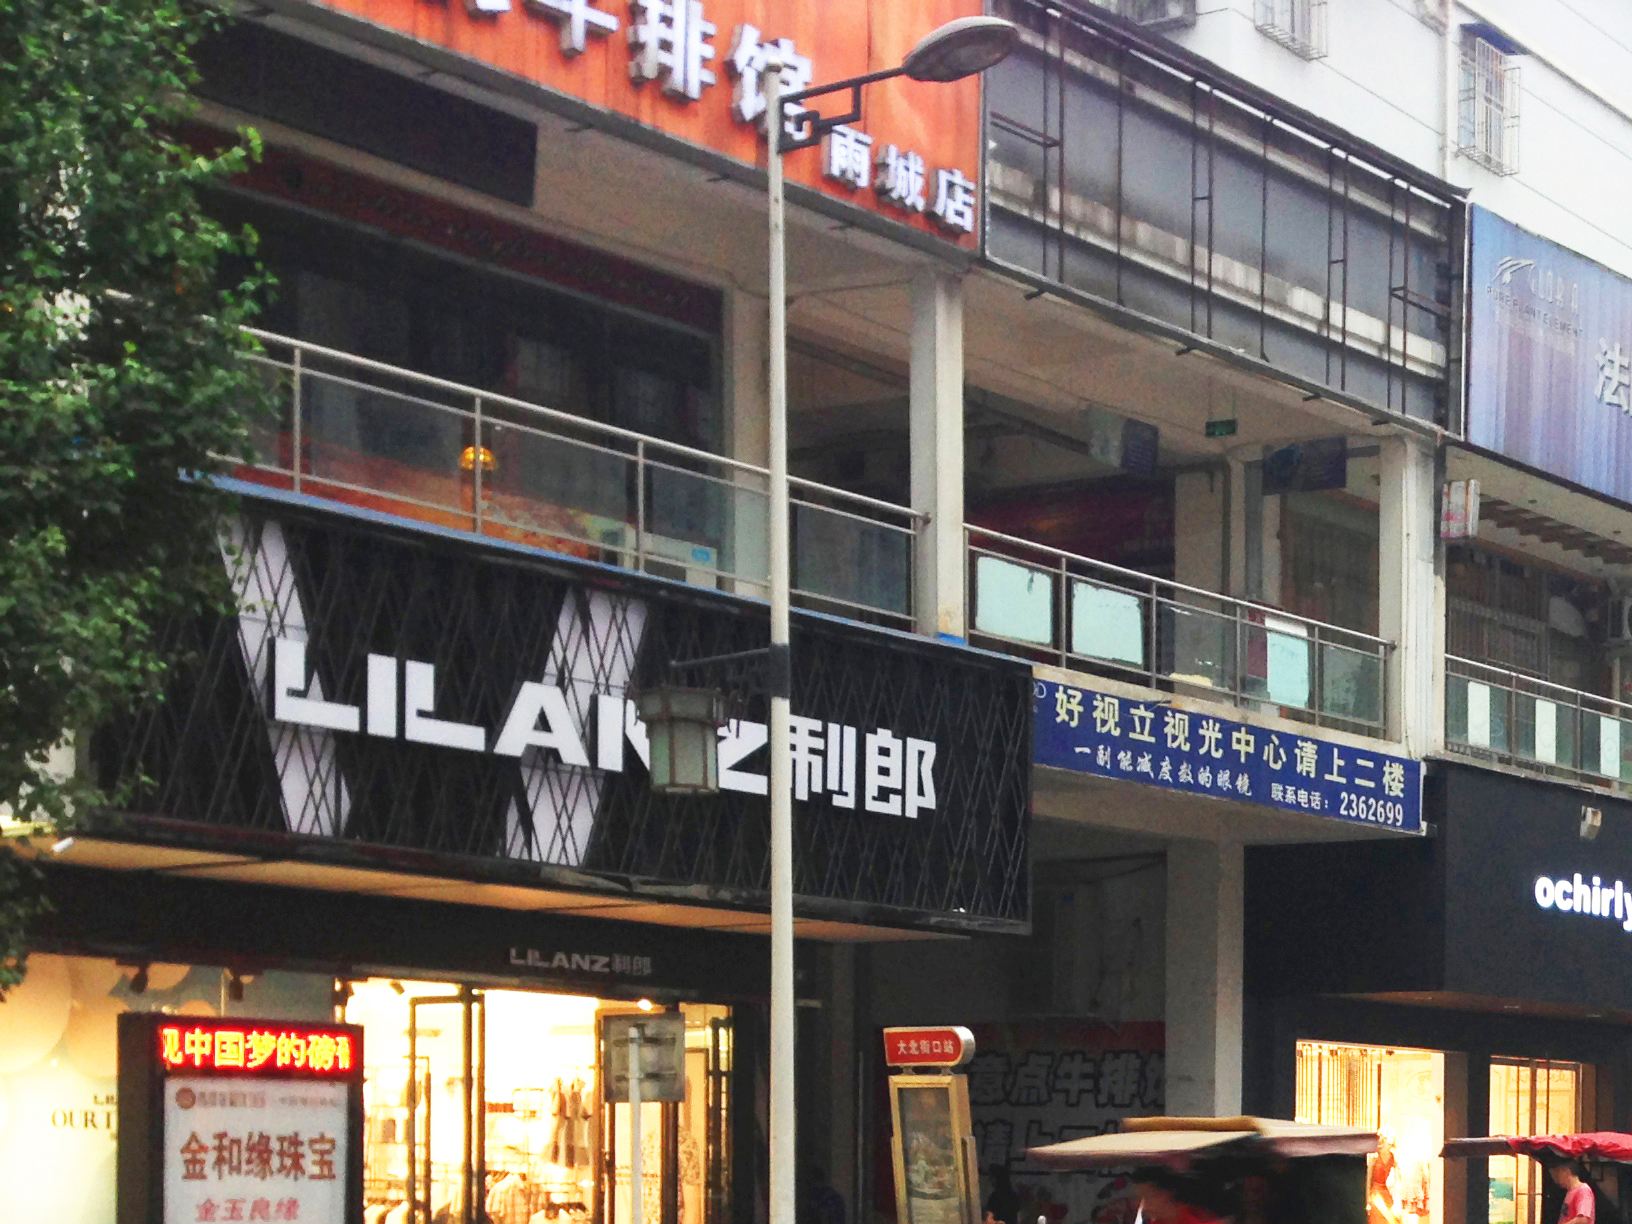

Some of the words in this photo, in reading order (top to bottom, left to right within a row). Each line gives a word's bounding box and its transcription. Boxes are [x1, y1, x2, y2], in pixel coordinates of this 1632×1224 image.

[822, 124, 976, 234] 雨城店
[789, 717, 938, 819] 利郎
[1338, 790, 1405, 828] 2362699
[509, 946, 611, 974] LILANZ
[896, 1039, 955, 1056] 大北街口站
[51, 1107, 99, 1132] OUR
[179, 1130, 337, 1182] 金和缘珠宝
